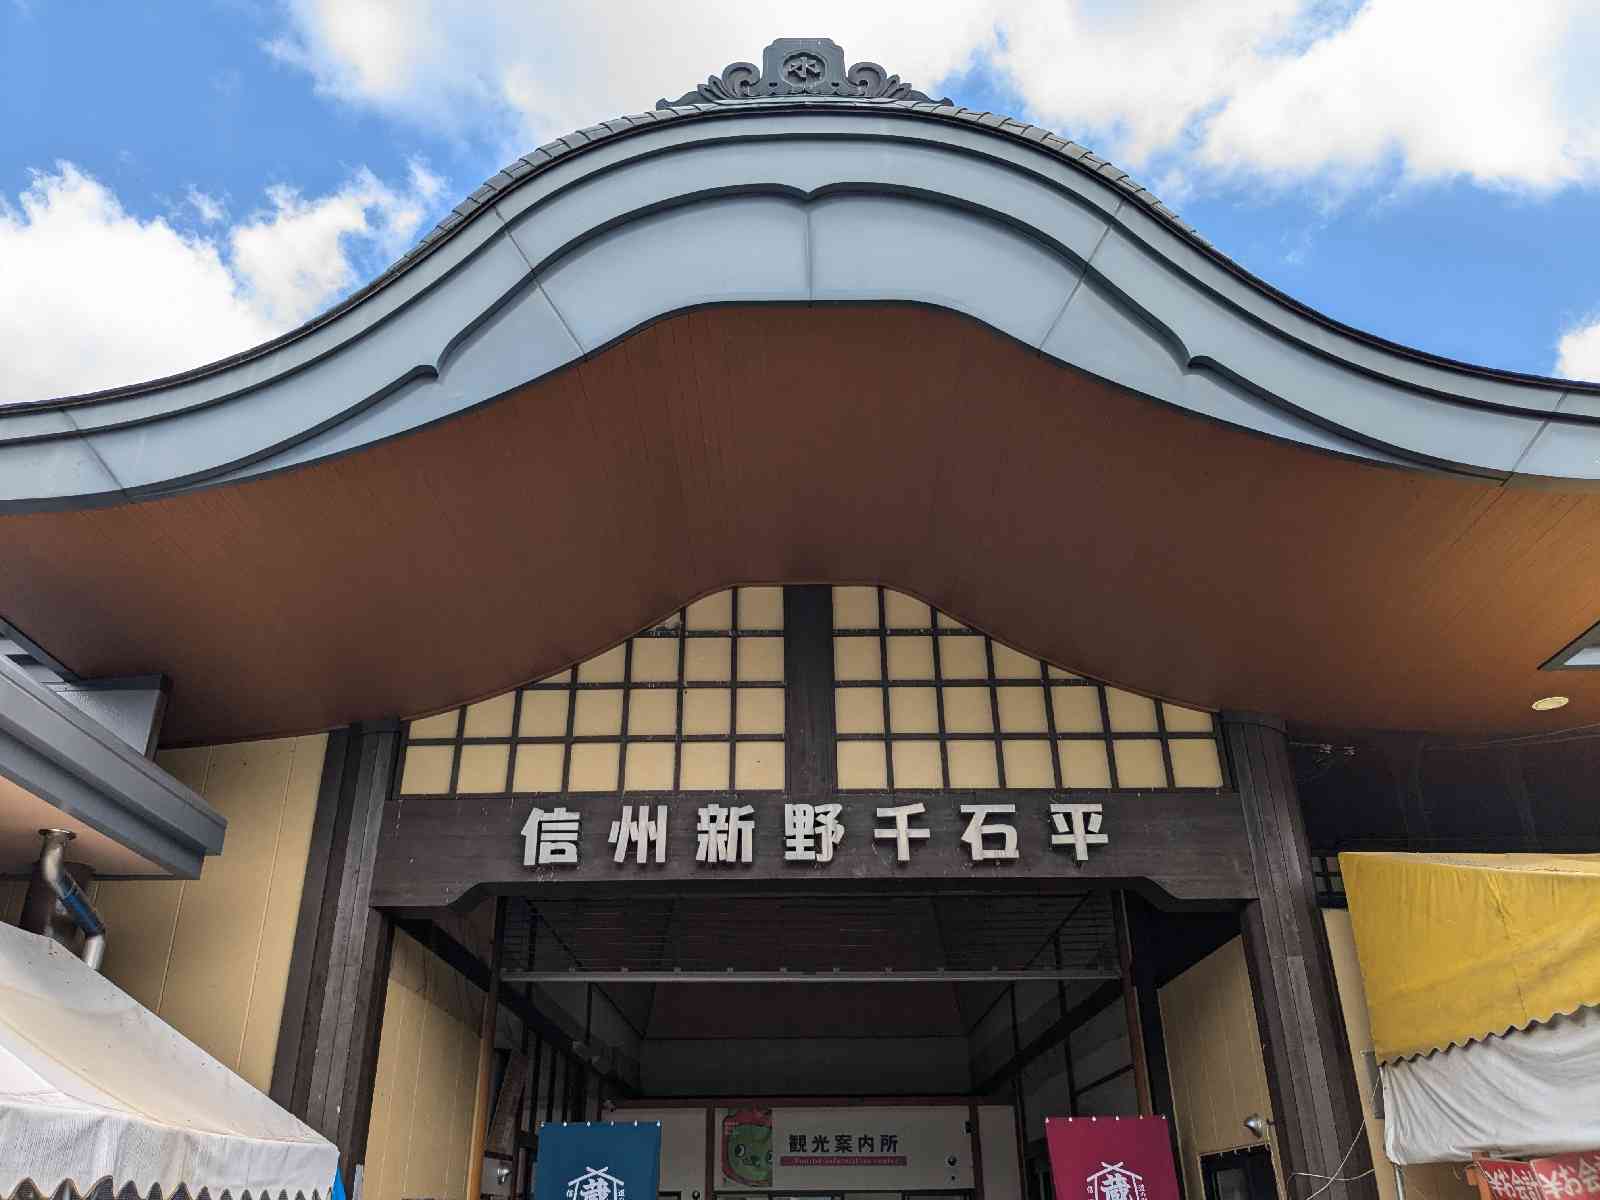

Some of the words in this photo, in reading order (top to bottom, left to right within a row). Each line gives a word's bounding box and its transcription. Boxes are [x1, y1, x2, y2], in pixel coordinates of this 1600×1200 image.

[521, 802, 1109, 866] 信州新野千石平
[788, 1134, 898, 1153] 観光案内所
